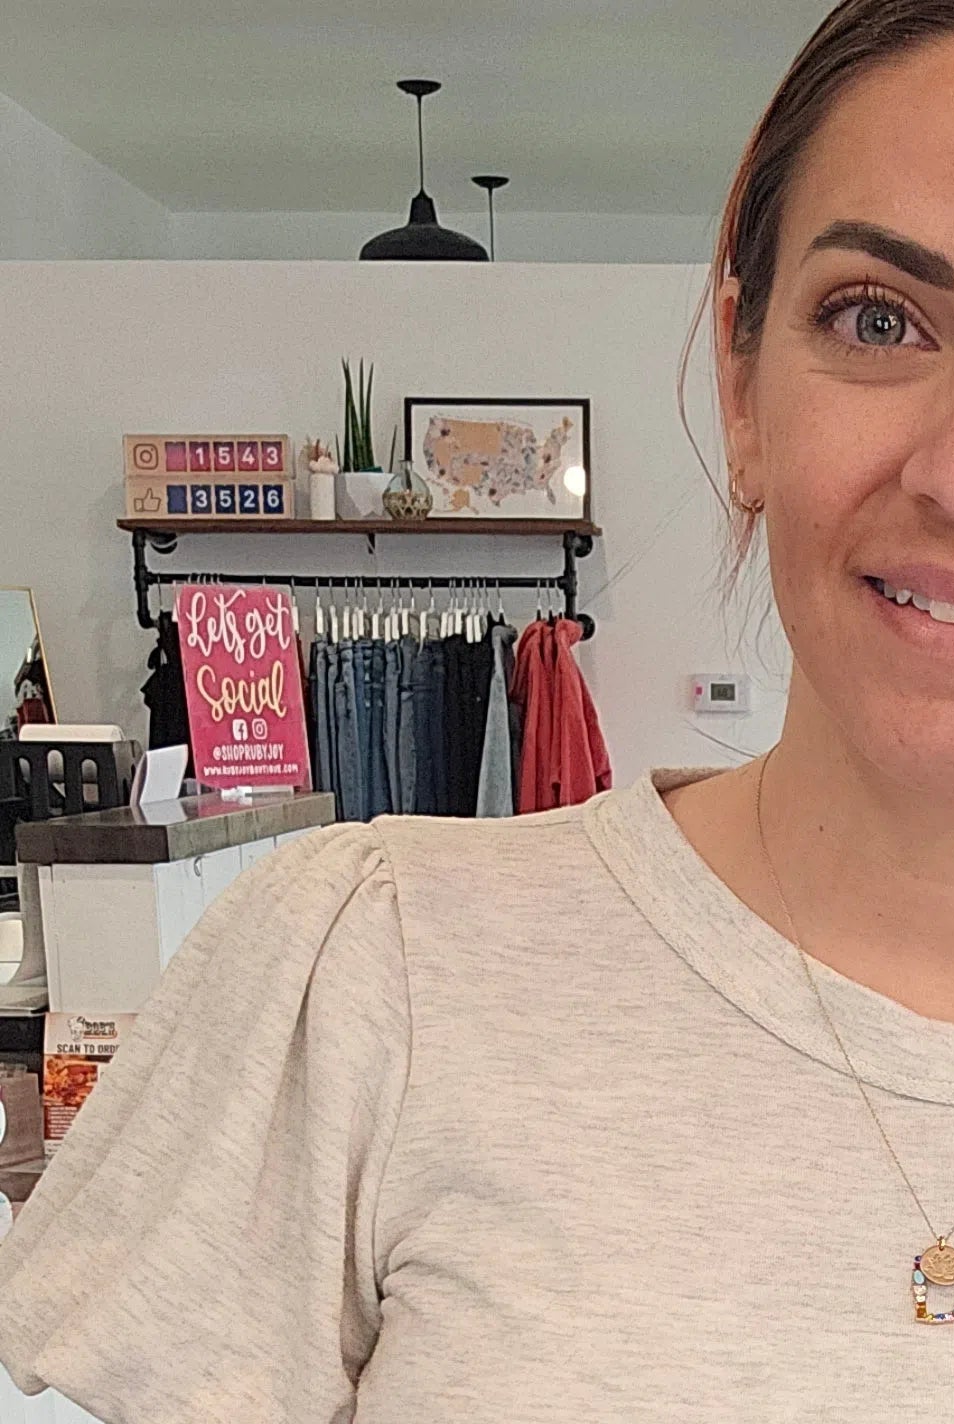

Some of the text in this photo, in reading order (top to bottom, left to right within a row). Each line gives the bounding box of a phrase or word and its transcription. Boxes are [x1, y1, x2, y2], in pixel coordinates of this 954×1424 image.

[195, 447, 279, 465] 1543
[195, 490, 280, 508] 3526
[245, 593, 290, 659] get
[197, 660, 287, 722] Social
[57, 1043, 81, 1053] SCAN
[84, 1044, 95, 1053] TO
